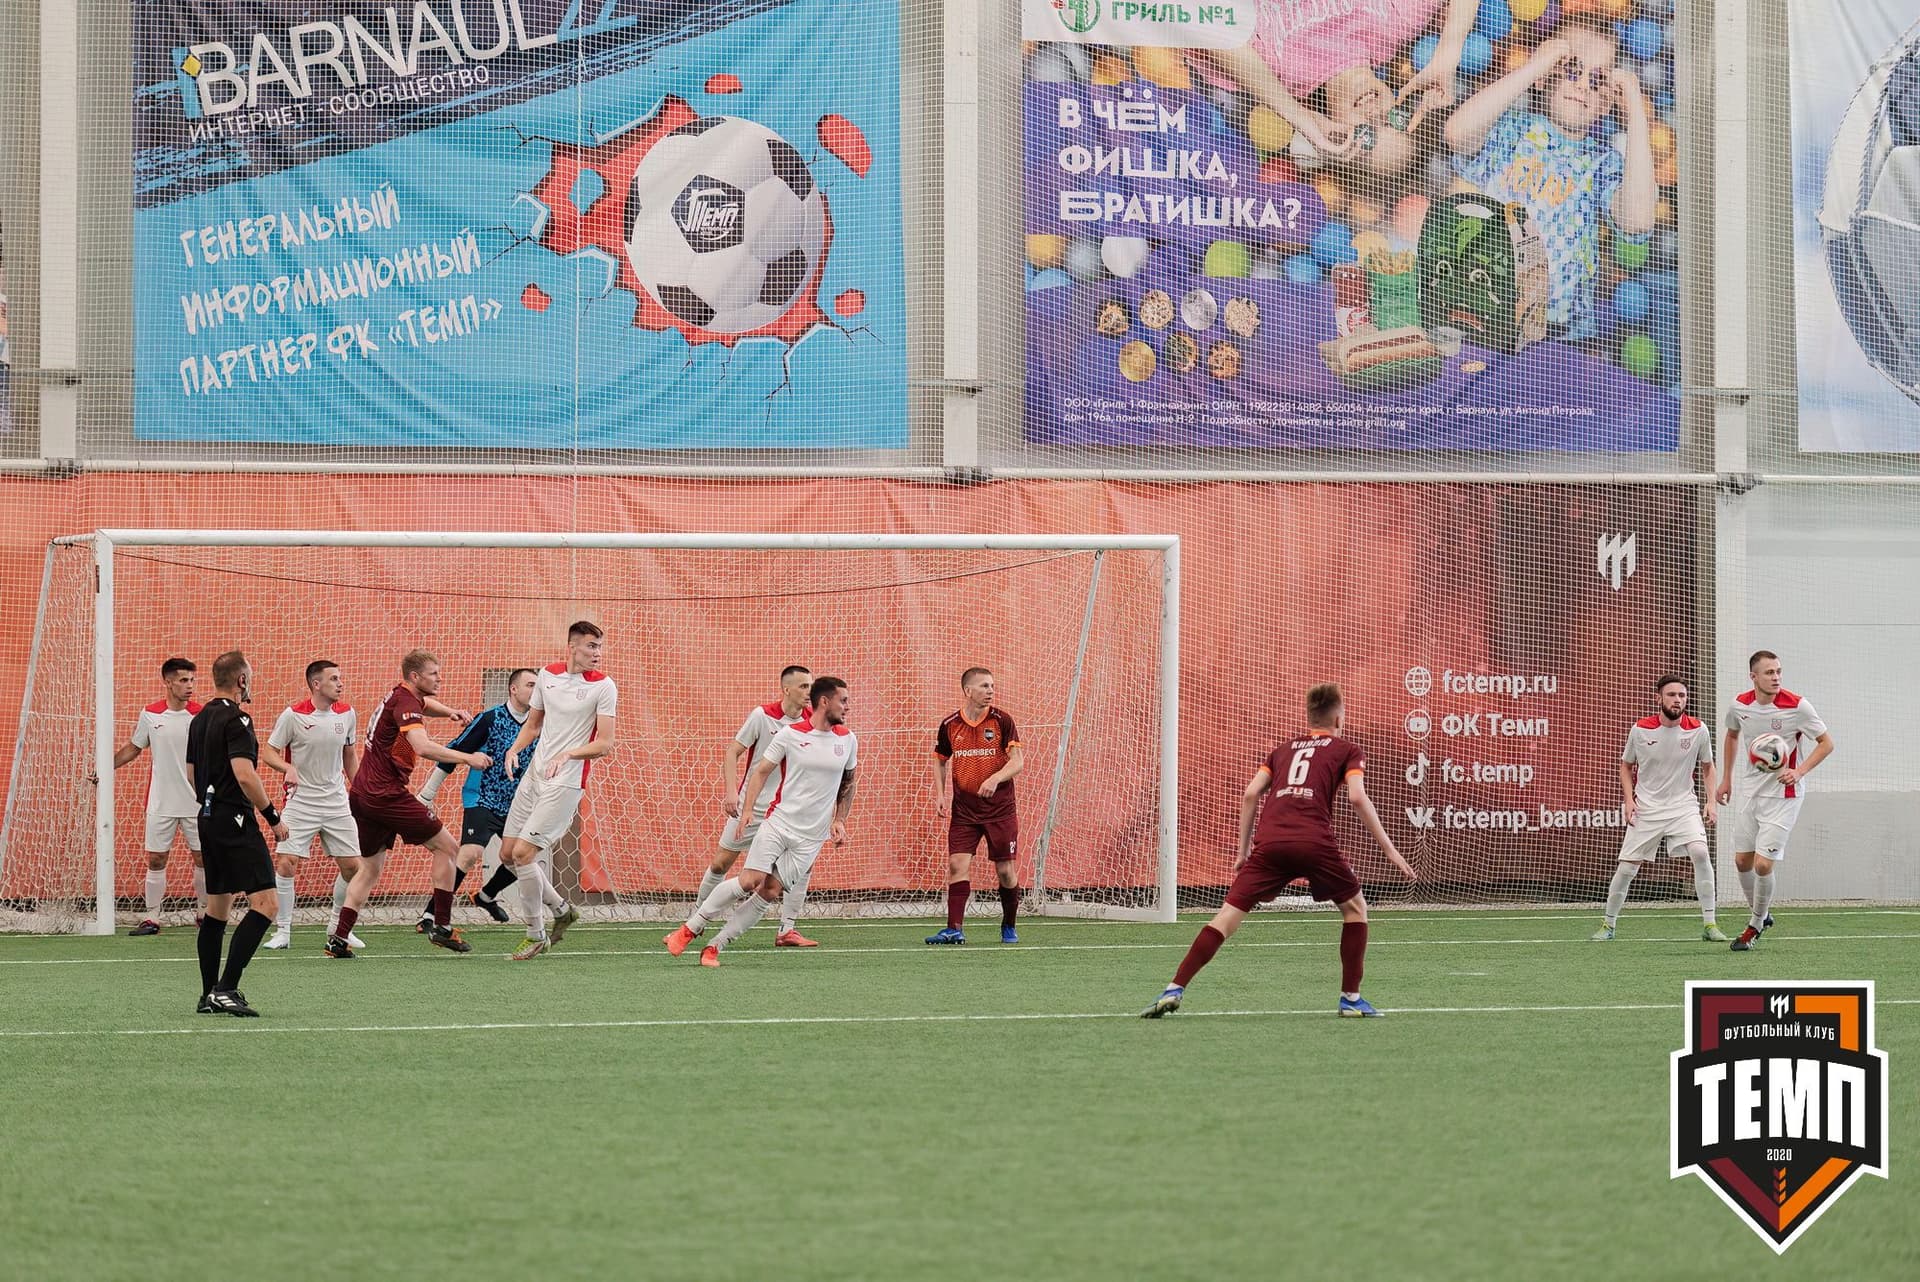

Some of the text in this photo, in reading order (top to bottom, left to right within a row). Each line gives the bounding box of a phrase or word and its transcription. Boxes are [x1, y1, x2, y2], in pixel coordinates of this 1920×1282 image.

[1112, 1, 1236, 25] ГРИЛЬ №1
[189, 102, 307, 142] ИНТЕРНЕТ
[330, 65, 489, 115] СООБЩЕСТВО
[1059, 87, 1186, 133] В ЧЁМ
[1058, 144, 1238, 188] ФИШКА,
[180, 181, 401, 267] ГЕНЕРАЛЬНЫЙ
[1060, 190, 1302, 229] БРАТИШКА?
[181, 228, 481, 335] ИНФОРМАЦИОННЫЙ
[179, 295, 502, 397] ПАРТНЕР ФК «ТЕМП»
[1064, 398, 1090, 408] ООО
[1443, 670, 1557, 698] fctemp.ru
[1441, 713, 1549, 736] ФК Темп
[1288, 747, 1315, 786] 6
[1442, 759, 1533, 787] fc.temp
